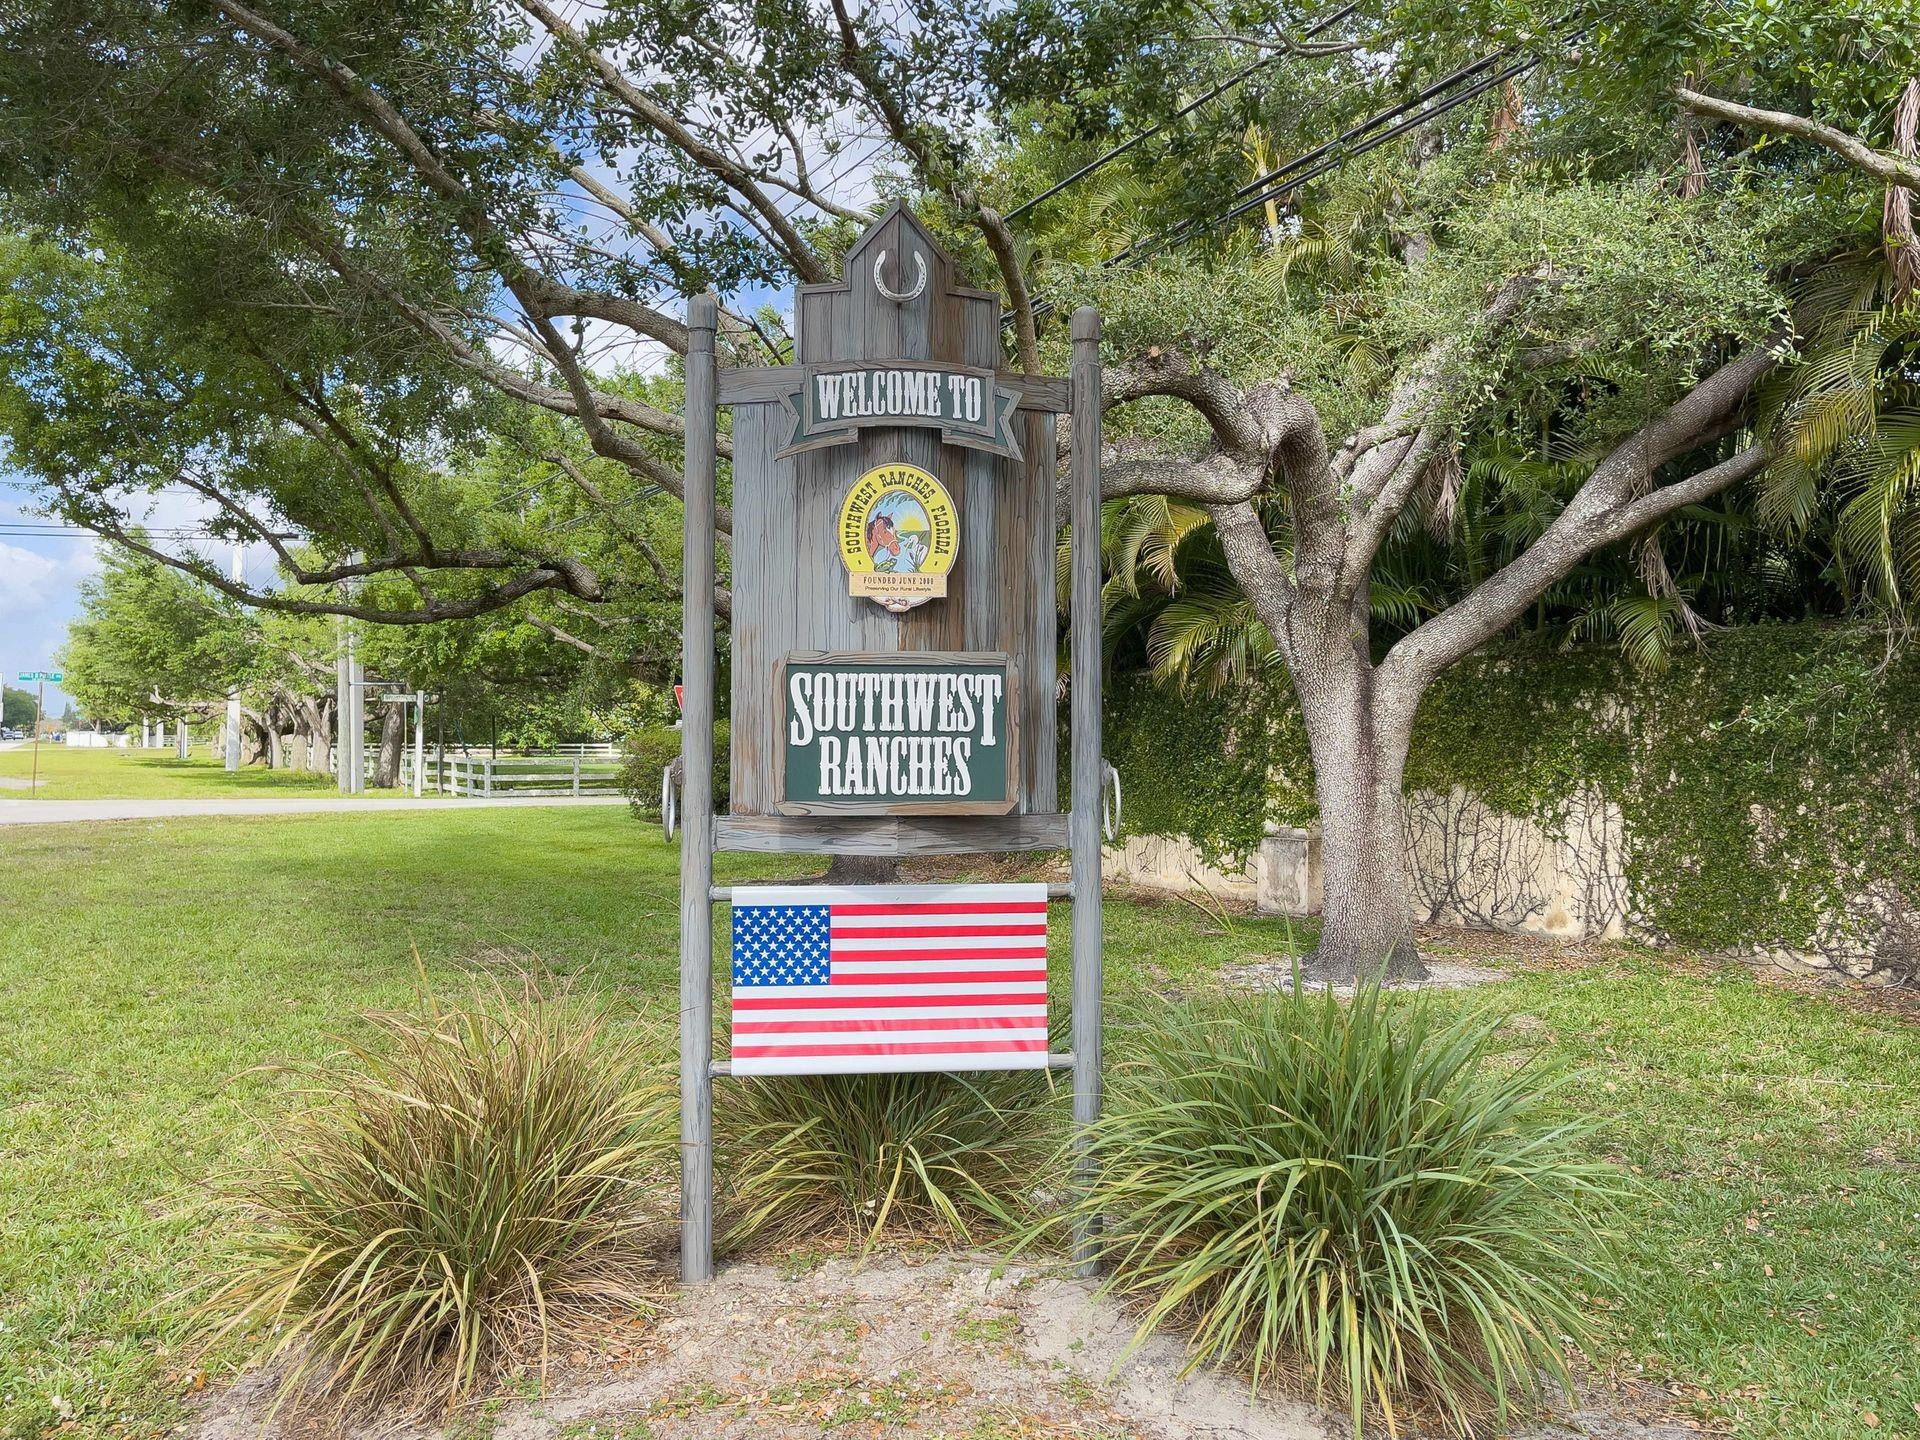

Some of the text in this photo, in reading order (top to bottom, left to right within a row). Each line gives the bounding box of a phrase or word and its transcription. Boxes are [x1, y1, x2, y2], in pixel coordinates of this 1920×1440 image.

[816, 370, 982, 422] WELCOME TO
[845, 471, 951, 556] SOUTHWEST RANCHES, FLORIDA
[863, 576, 897, 585] FOUNDED
[899, 576, 917, 585] JUNE
[789, 671, 1003, 747] SOUTHWEST
[817, 735, 972, 797] RANCHES
